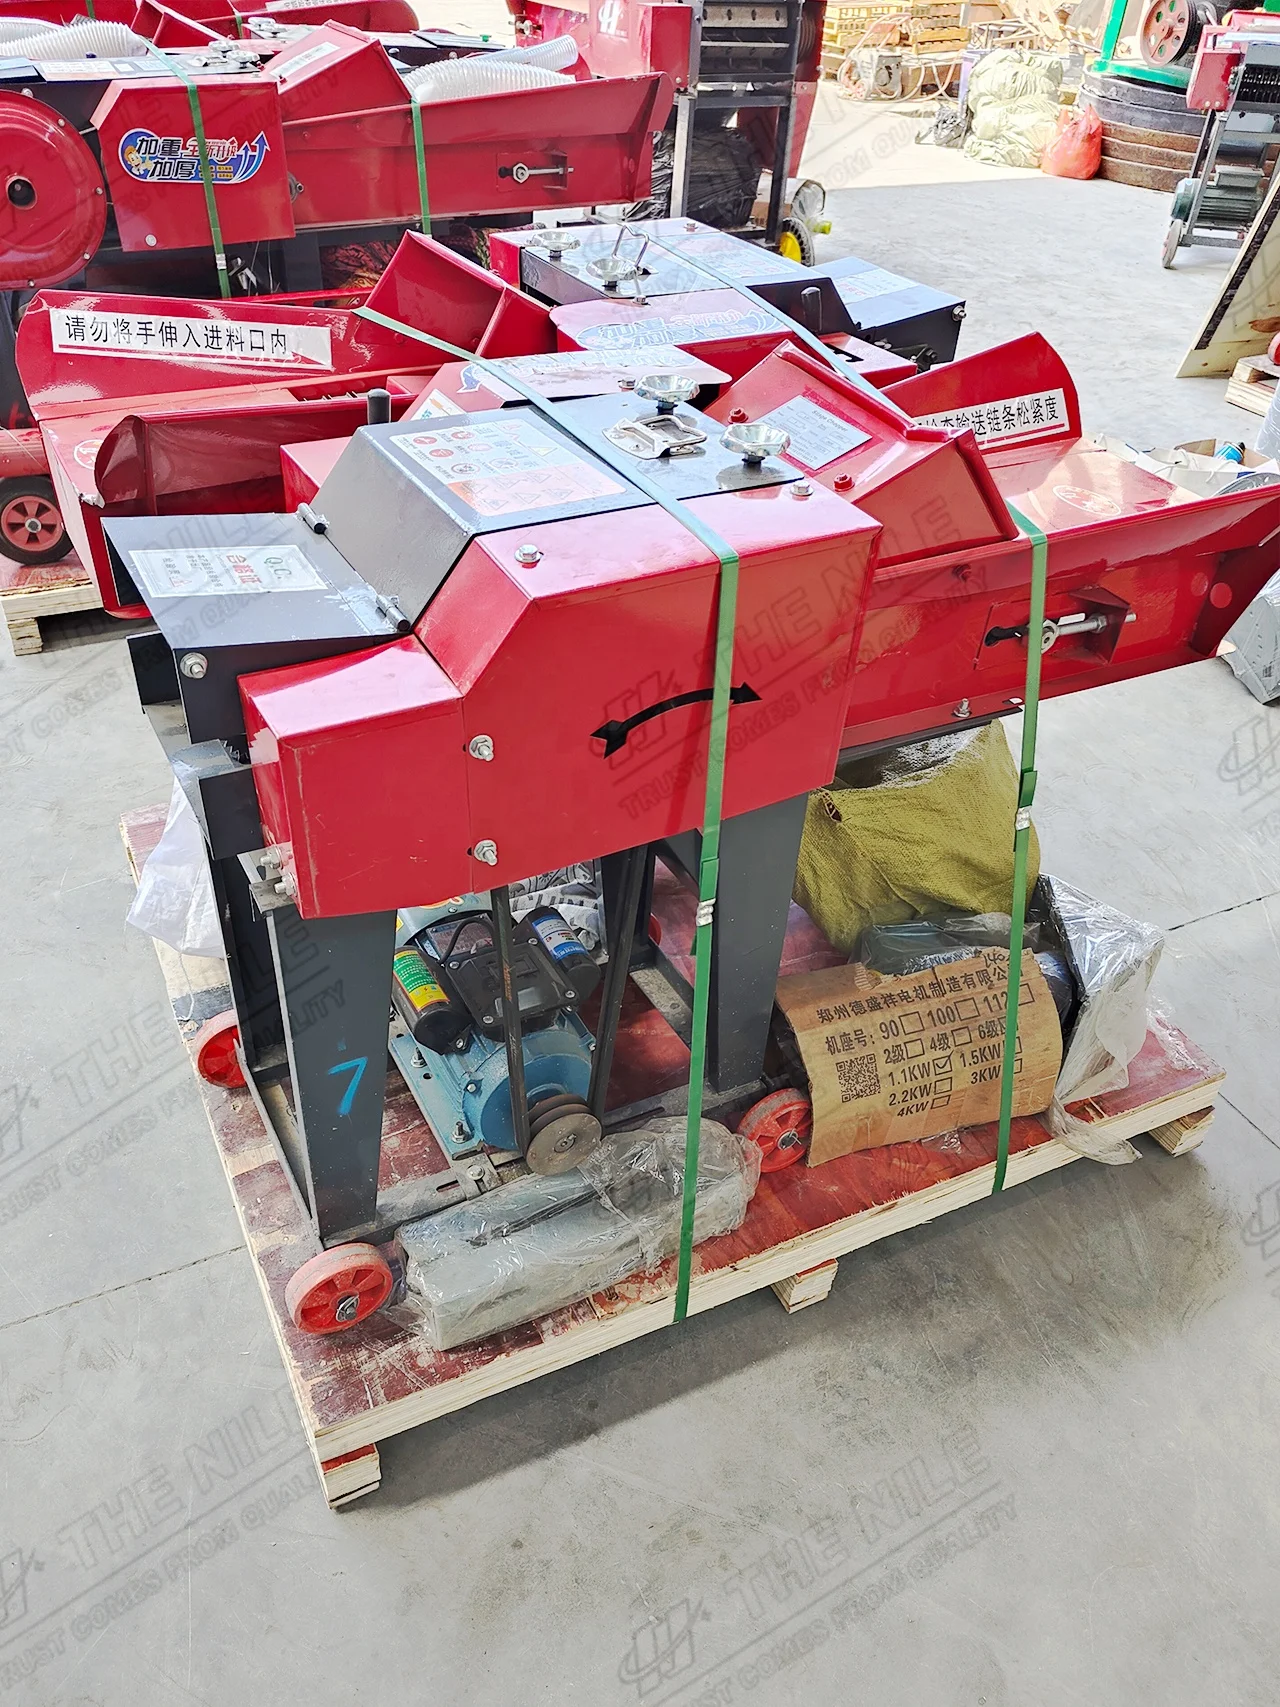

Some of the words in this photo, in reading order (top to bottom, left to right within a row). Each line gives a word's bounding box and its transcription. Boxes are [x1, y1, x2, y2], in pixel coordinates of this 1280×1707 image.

[137, 138, 182, 157] 加重
[151, 161, 195, 178] 加厚
[65, 315, 287, 354] 请勿将手伸入进料口内
[880, 1018, 899, 1040] 90
[928, 1005, 956, 1028] 100
[884, 1043, 906, 1065] 2级
[930, 1033, 951, 1051] 4级
[978, 1020, 1000, 1040] 6级
[888, 1061, 931, 1087] 1.1KW
[960, 1043, 1001, 1068] 1.5KW
[327, 1056, 368, 1116] 7
[889, 1083, 932, 1107] 2.2KW
[970, 1064, 1001, 1085] 3KW
[897, 1101, 929, 1117] 4KW
